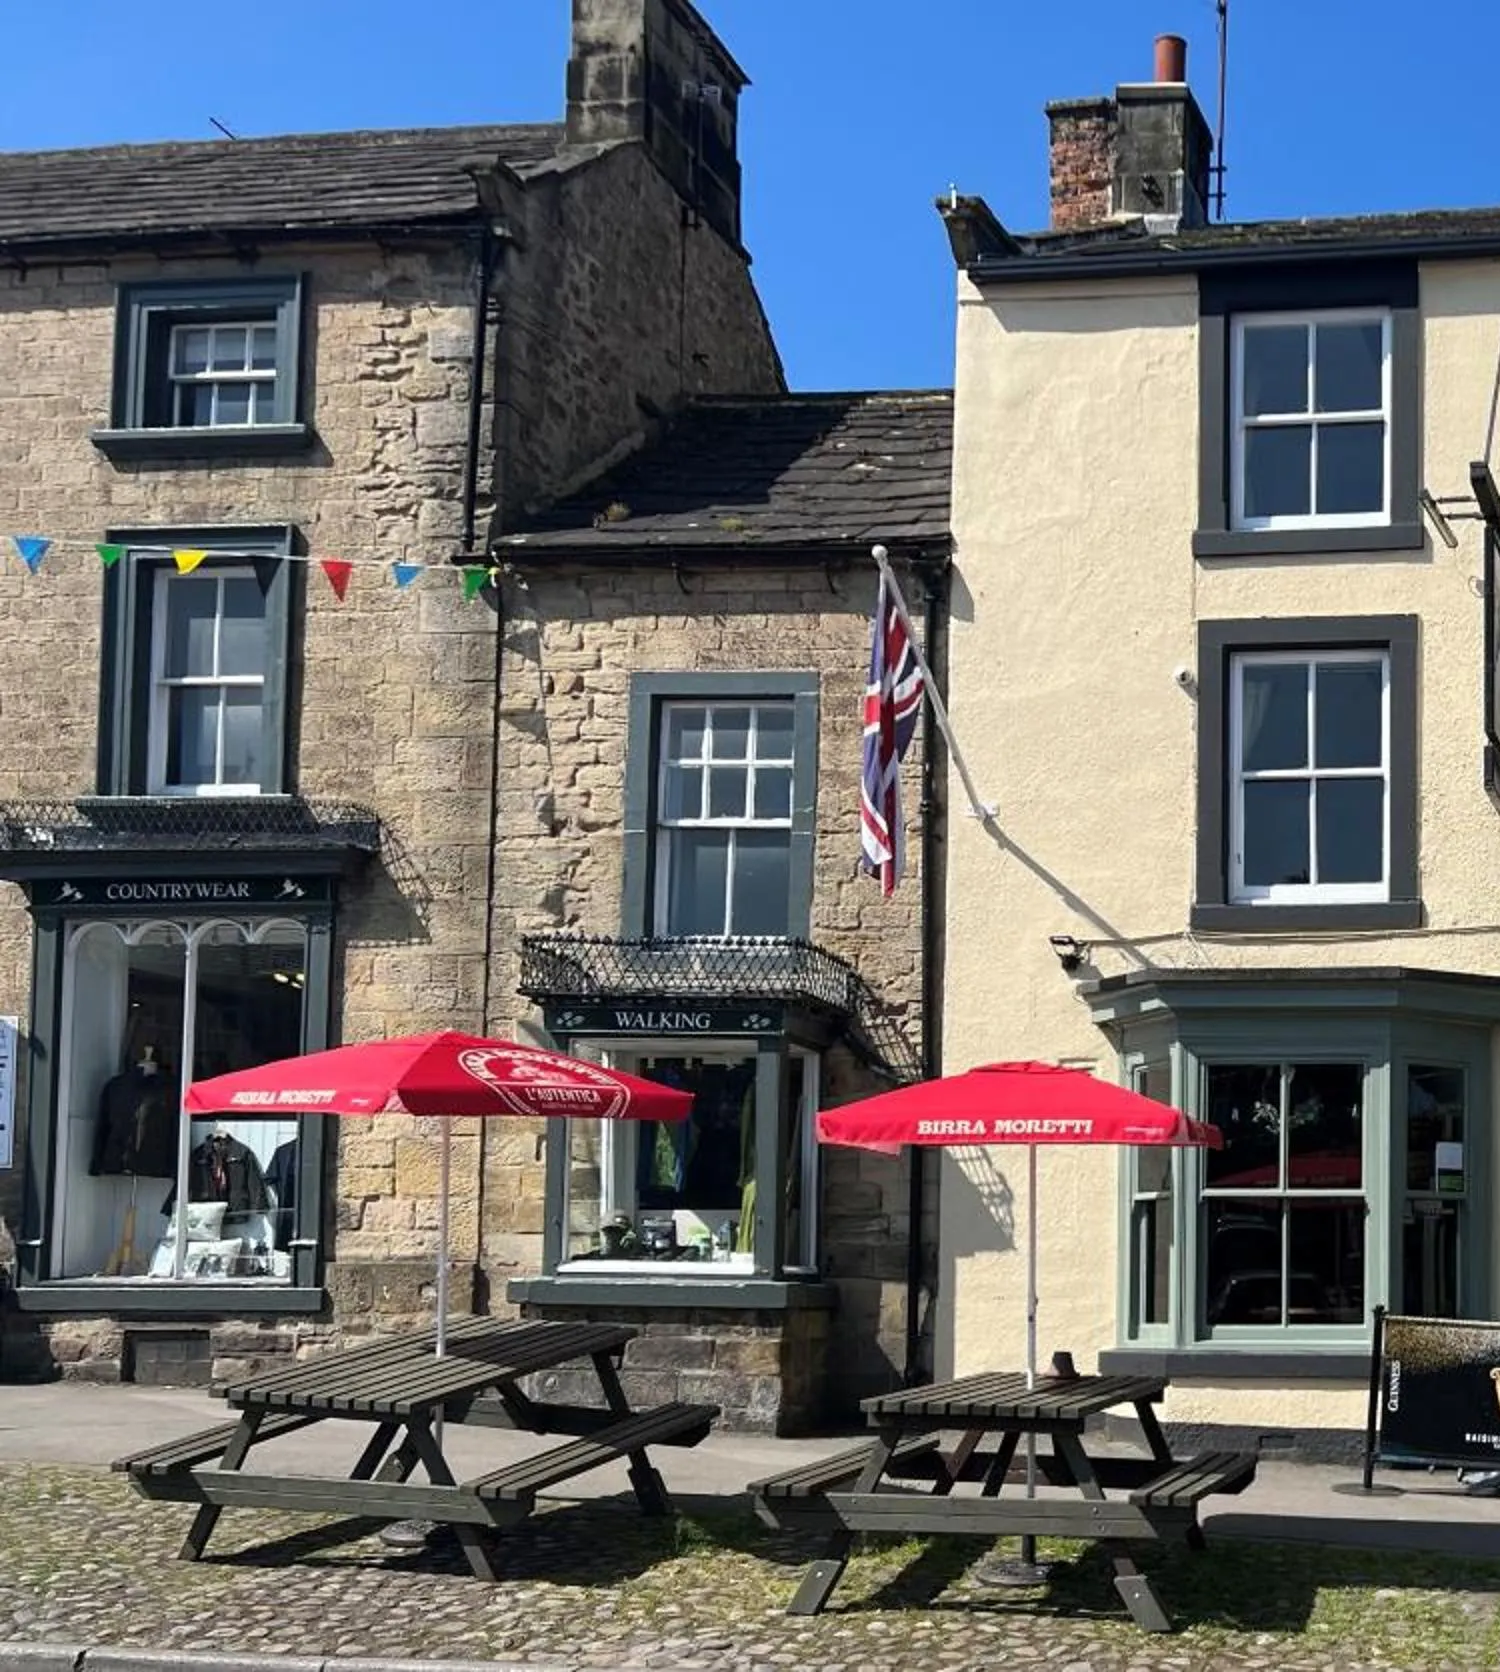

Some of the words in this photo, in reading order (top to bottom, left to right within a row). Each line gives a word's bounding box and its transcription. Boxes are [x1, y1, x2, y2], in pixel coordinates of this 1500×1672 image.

[106, 882, 250, 900] COUNTRYWEAR
[615, 1011, 711, 1029] WALKING
[525, 1087, 602, 1103] L'AUTENTICA
[916, 1120, 987, 1135] BIRRA
[994, 1119, 1093, 1134] MORETTI
[1387, 1360, 1401, 1412] GUINNESS
